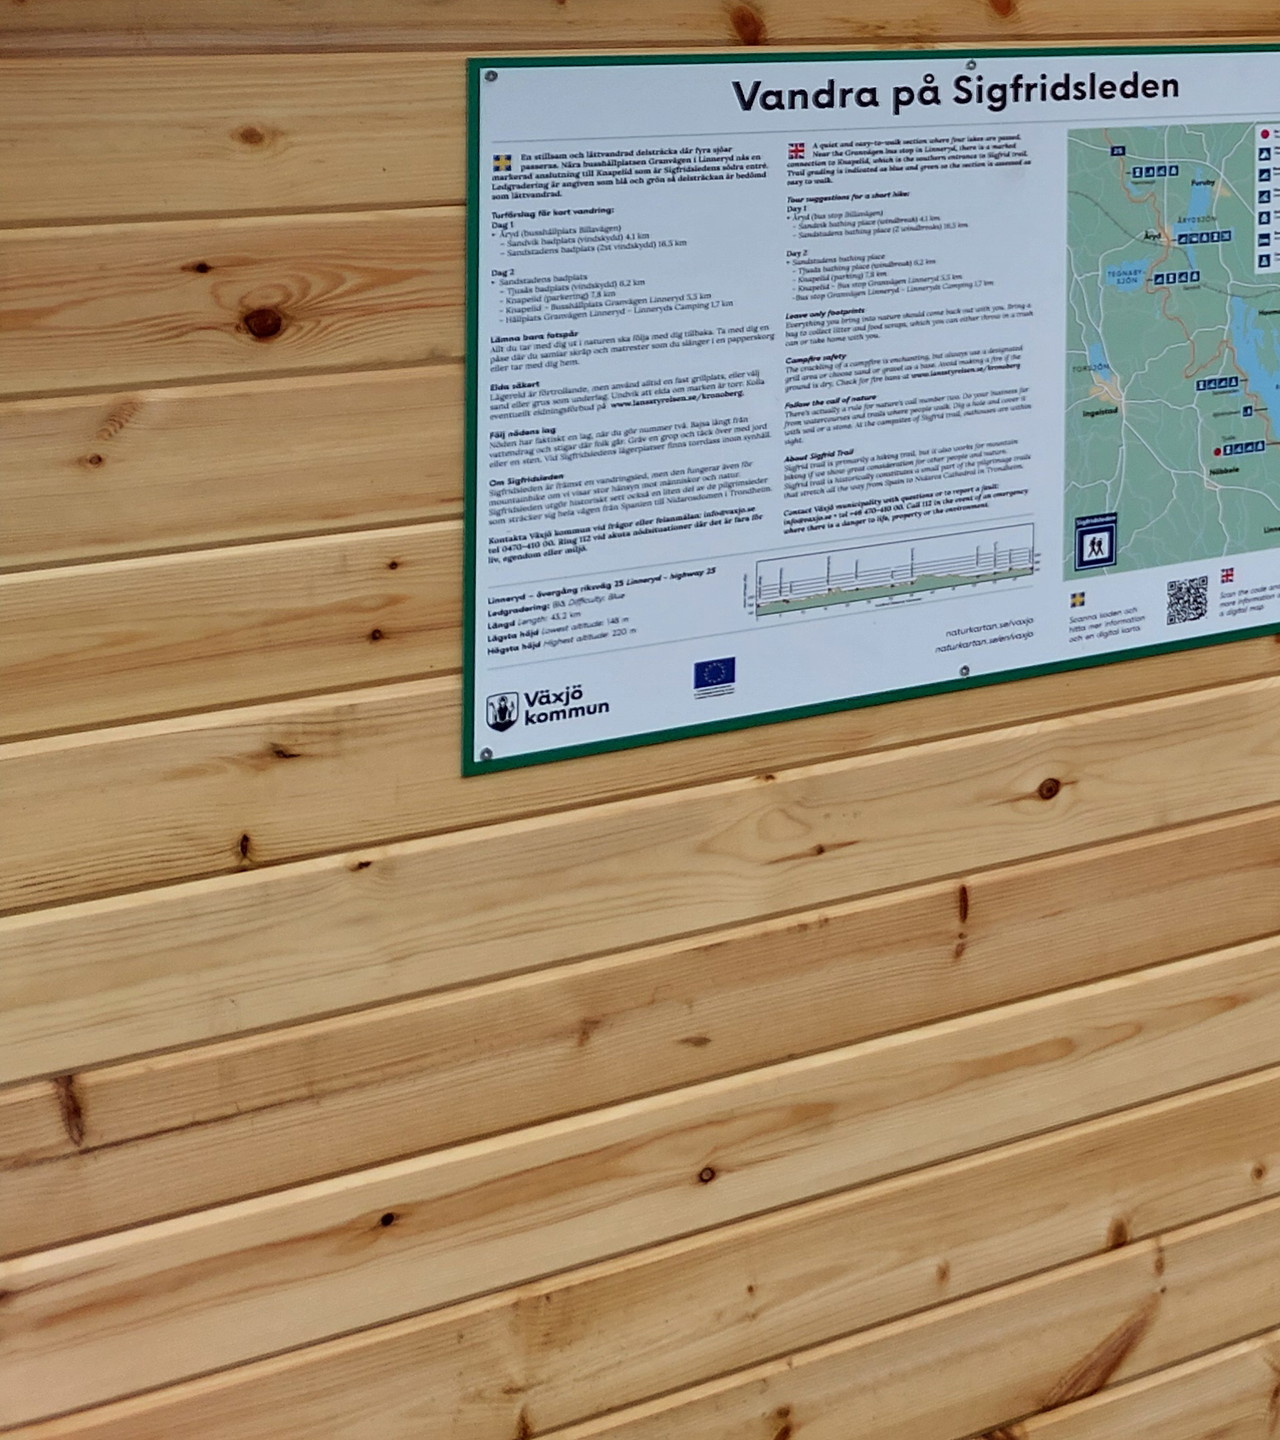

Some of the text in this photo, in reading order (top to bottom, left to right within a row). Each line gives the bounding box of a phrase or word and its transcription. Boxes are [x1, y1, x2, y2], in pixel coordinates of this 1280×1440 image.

[732, 70, 1179, 115] Vandra på Sigfridsleden
[1190, 178, 1215, 187] Furuby
[1143, 229, 1162, 242] Åryd
[490, 268, 508, 278] Dag
[524, 683, 583, 713] Växjö
[524, 696, 609, 726] kommun
